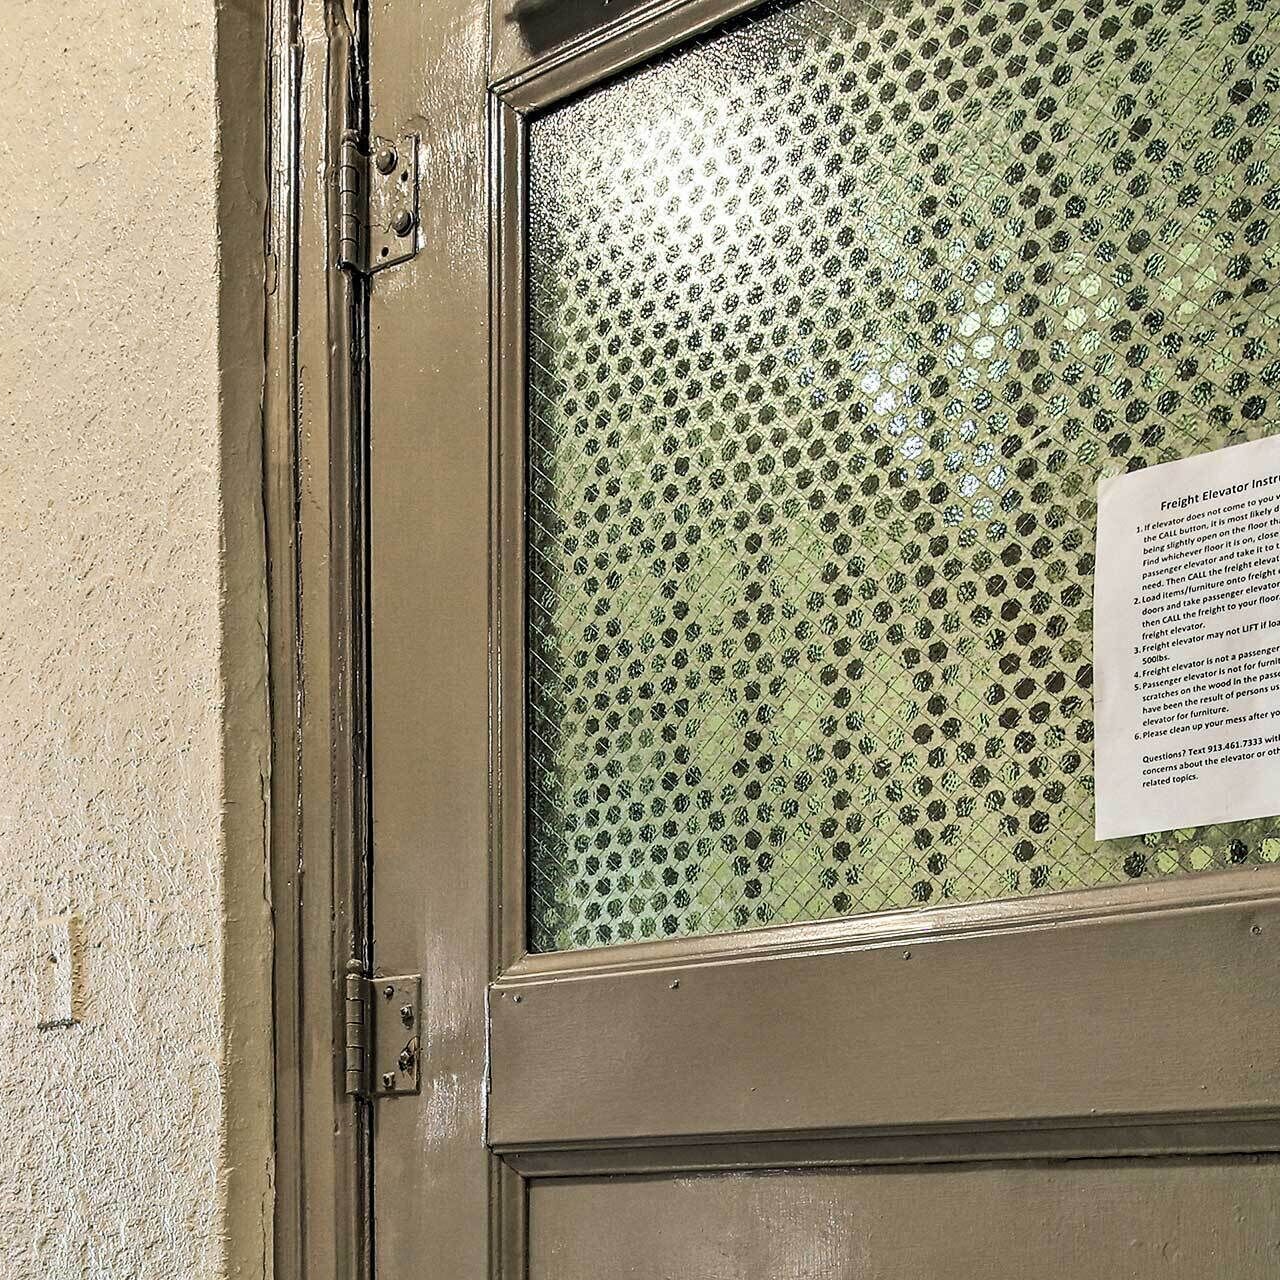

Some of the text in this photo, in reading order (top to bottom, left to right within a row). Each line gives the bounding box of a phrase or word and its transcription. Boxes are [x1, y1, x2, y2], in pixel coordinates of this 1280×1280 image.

[1160, 494, 1199, 511] Freight
[1202, 482, 1249, 501] Elevator
[1143, 535, 1156, 543] the
[1158, 529, 1177, 539] CALL
[1179, 523, 1209, 535] button,
[1227, 513, 1248, 523] most
[1250, 507, 1272, 518] likely
[1151, 517, 1184, 529] elevator
[1186, 512, 1205, 521] does
[1207, 507, 1221, 516] not
[1222, 502, 1245, 513] come
[1258, 495, 1274, 505] you
[1142, 556, 1159, 566] Find
[1161, 548, 1202, 562] whichever
[1204, 543, 1224, 552] floor
[1241, 536, 1255, 544] on,
[1257, 531, 1279, 541] close
[1143, 545, 1165, 555] being
[1166, 537, 1195, 549] slightly
[1196, 533, 1217, 543] open
[1231, 526, 1245, 534] the
[1248, 521, 1267, 530] floor
[1141, 580, 1164, 591] need.
[1166, 576, 1185, 585] Then
[1187, 570, 1207, 581] CALL
[1208, 568, 1222, 576] the
[1224, 561, 1251, 573] freight
[1142, 564, 1182, 580] passenger
[1183, 557, 1217, 569] elevator
[1218, 551, 1234, 562] and
[1236, 548, 1254, 558] take
[1141, 606, 1164, 615] doors
[1166, 600, 1181, 610] and
[1183, 597, 1200, 607] take
[1202, 589, 1244, 604] passenger
[1245, 581, 1280, 594] elevator
[1142, 592, 1161, 603] Load
[1162, 580, 1224, 599] items/furniture
[1226, 576, 1246, 585] onto
[1248, 568, 1275, 581] freight
[1142, 619, 1160, 628] then
[1162, 614, 1181, 624] CALL
[1182, 611, 1196, 619] the
[1198, 604, 1225, 616] freight
[1238, 599, 1257, 610] your
[1142, 622, 1205, 640] freight elevator.
[1142, 641, 1169, 652] Freight
[1171, 634, 1204, 647] elevator
[1206, 631, 1224, 640] may
[1225, 627, 1240, 636] not
[1242, 622, 1259, 633] LIFT
[1142, 654, 1170, 665] 500lbs.
[1142, 666, 1169, 677] Freight
[1171, 659, 1205, 671] elevator
[1214, 654, 1229, 663] not
[1238, 645, 1280, 661] passenger
[1142, 676, 1181, 689] Passenger
[1183, 670, 1217, 681] elevator
[1227, 665, 1241, 673] not
[1243, 662, 1256, 671] for
[1142, 689, 1179, 702] scratches
[1192, 684, 1206, 692] the
[1208, 678, 1231, 690] wood
[1243, 675, 1257, 683] the
[1142, 705, 1161, 714] have
[1163, 701, 1183, 710] been
[1184, 698, 1198, 706] the
[1200, 693, 1223, 704] result
[1236, 686, 1268, 699] persons
[1142, 706, 1229, 726] elevator for furniture.
[1142, 729, 1167, 738] Please
[1169, 725, 1190, 734] clean
[1192, 723, 1203, 731] up
[1204, 719, 1223, 729] your
[1225, 715, 1246, 724] mess
[1248, 711, 1268, 721] after
[1142, 749, 1186, 763] Questions?
[1188, 747, 1205, 756] Text
[1207, 737, 1262, 753] 913.461.7333
[1142, 764, 1177, 775] concerns
[1179, 760, 1202, 770] about
[1204, 757, 1218, 765] the
[1220, 752, 1254, 763] elevator
[1142, 773, 1198, 788] related topics.
